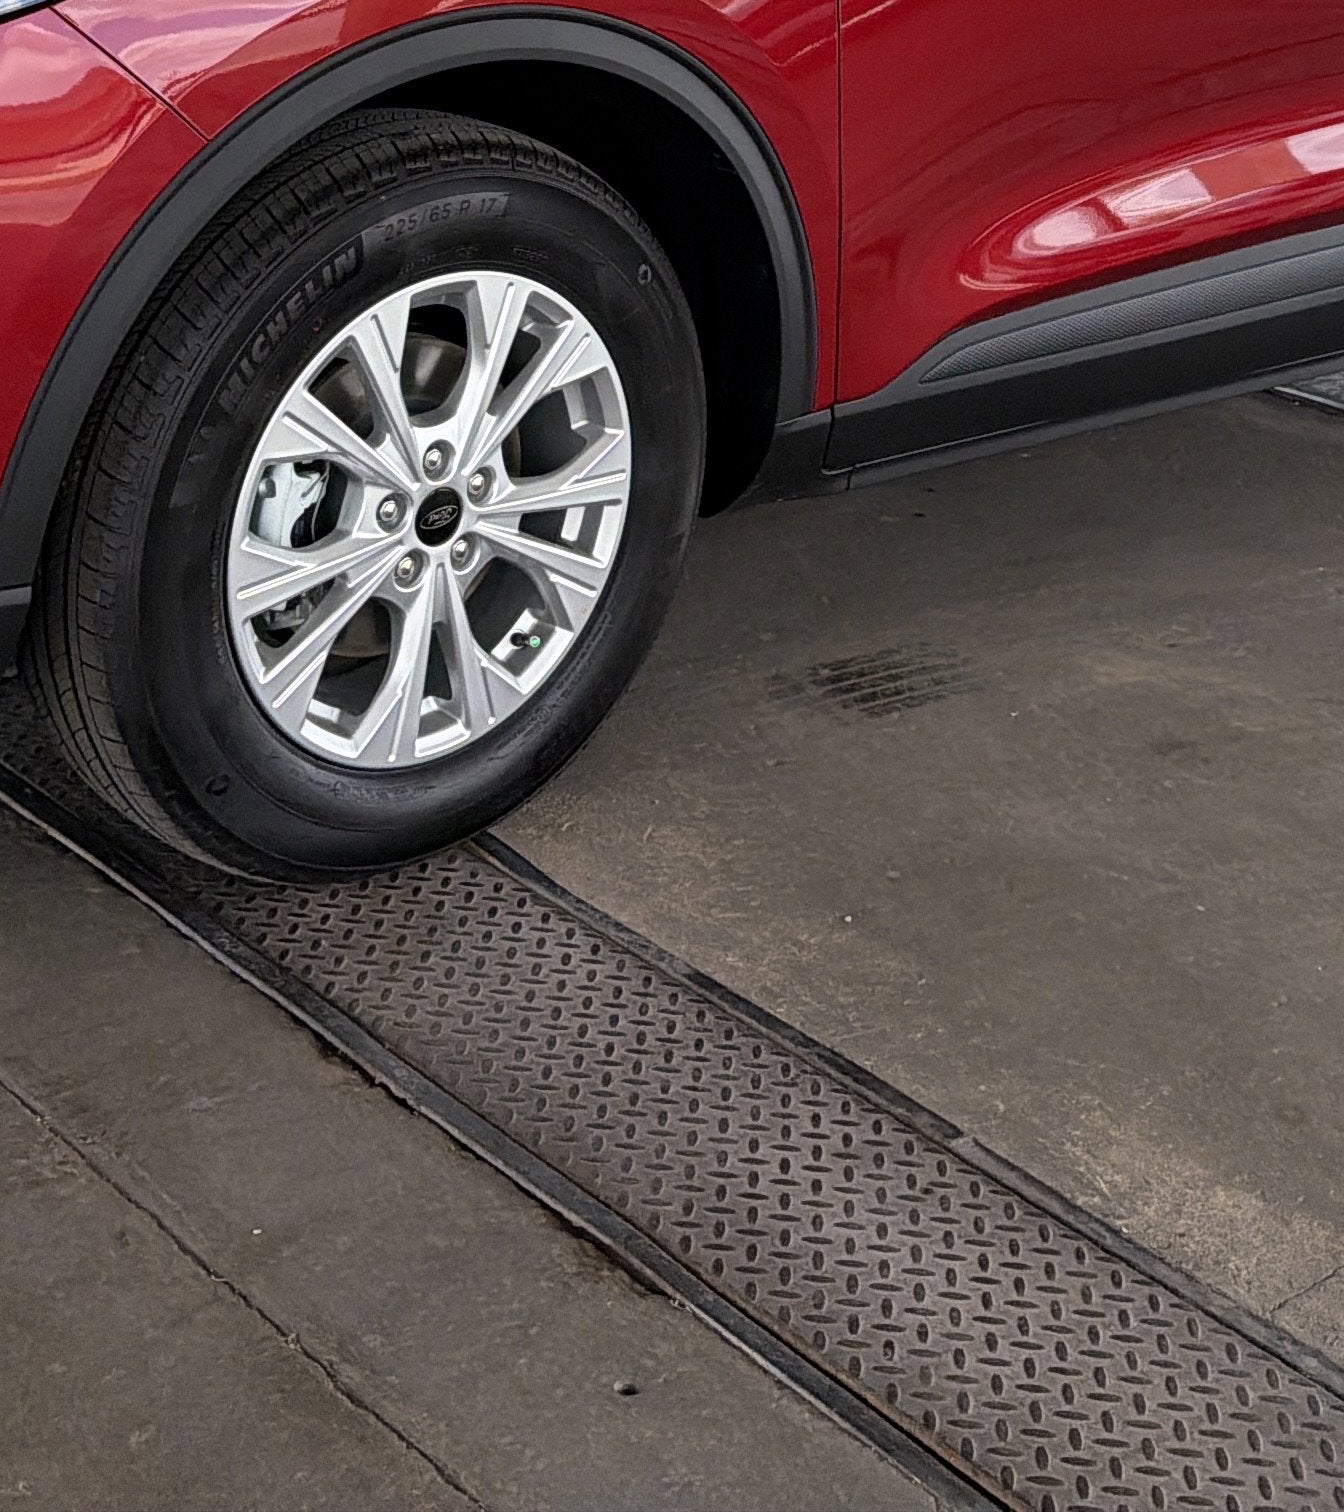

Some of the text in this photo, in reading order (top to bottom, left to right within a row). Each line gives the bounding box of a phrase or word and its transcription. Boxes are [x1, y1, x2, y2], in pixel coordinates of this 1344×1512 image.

[383, 197, 498, 242] 225/65 R 17
[218, 245, 358, 415] MICHELIN
